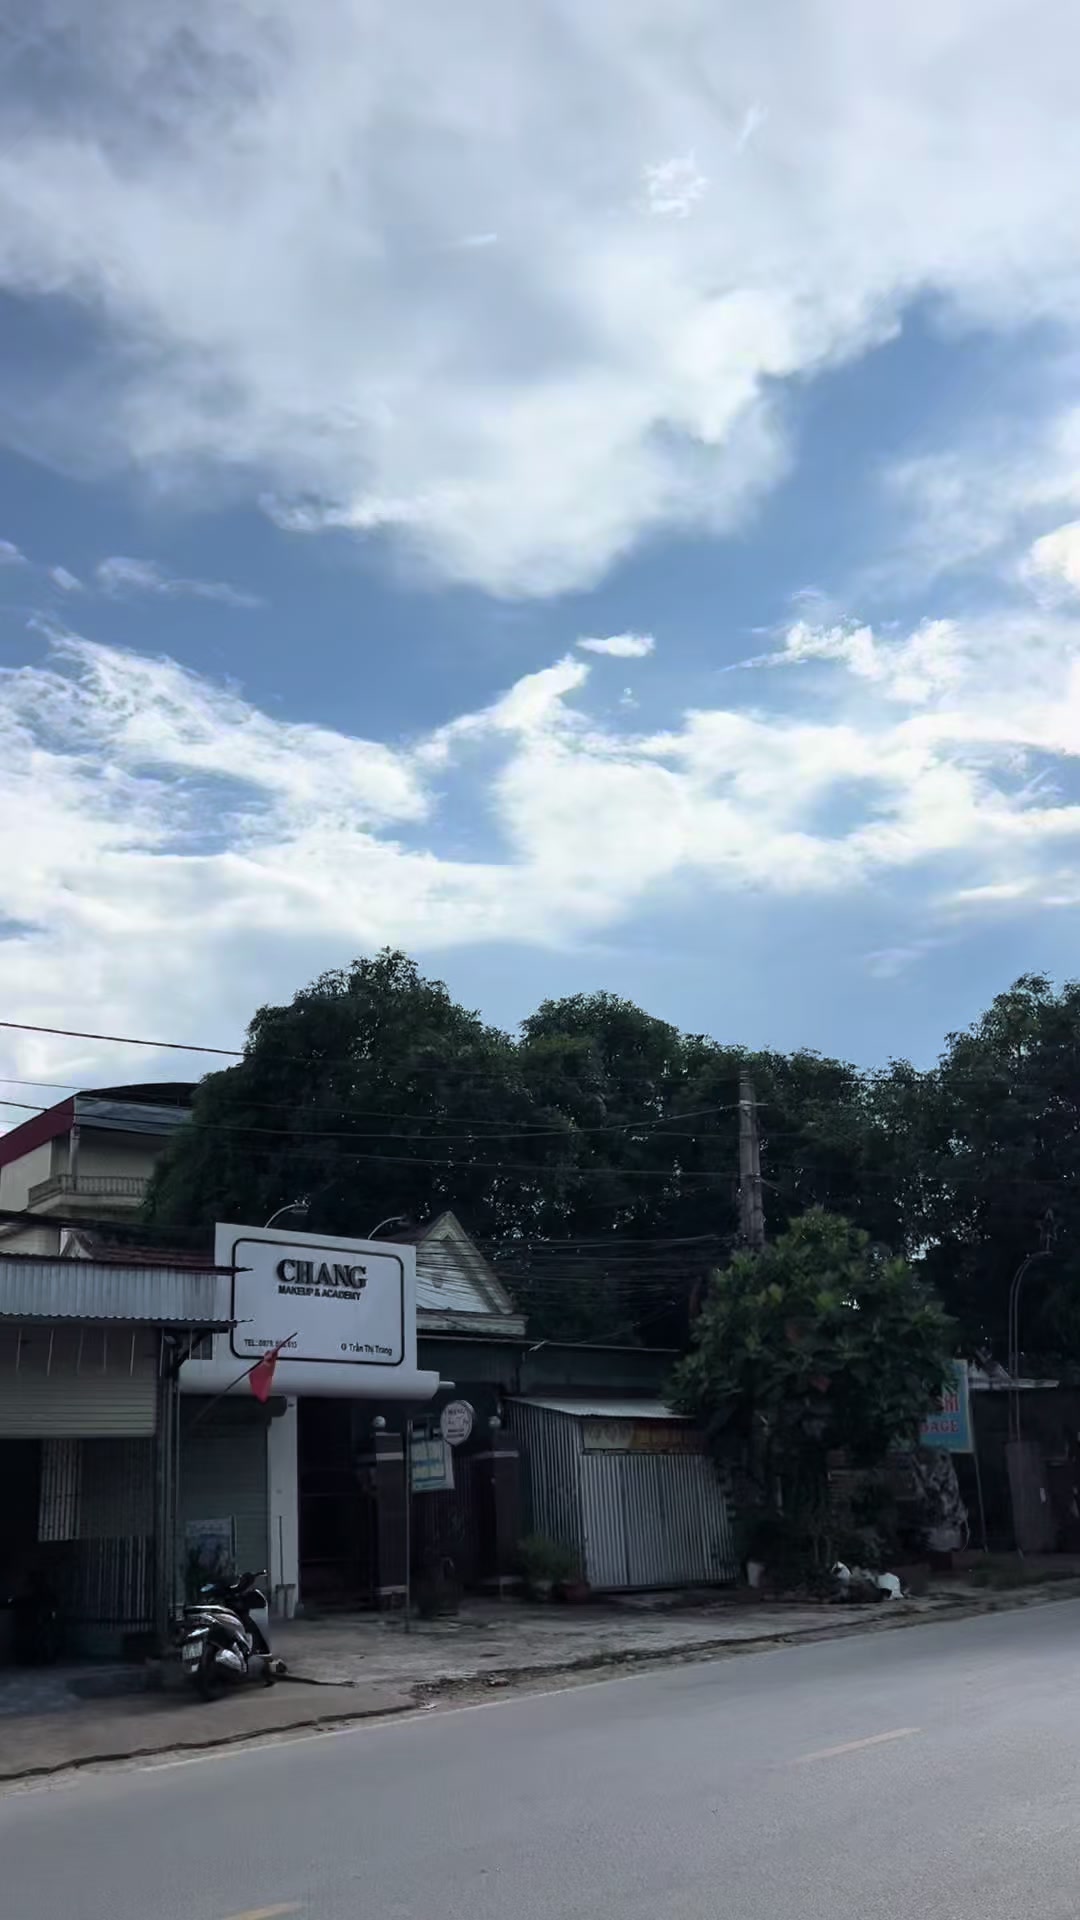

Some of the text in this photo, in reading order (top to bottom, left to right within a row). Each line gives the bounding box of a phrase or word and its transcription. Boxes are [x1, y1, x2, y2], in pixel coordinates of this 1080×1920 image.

[276, 1258, 368, 1289] CHANG
[278, 1285, 361, 1301] MAKEUP & ACADEMY
[375, 1345, 393, 1357] Trang
